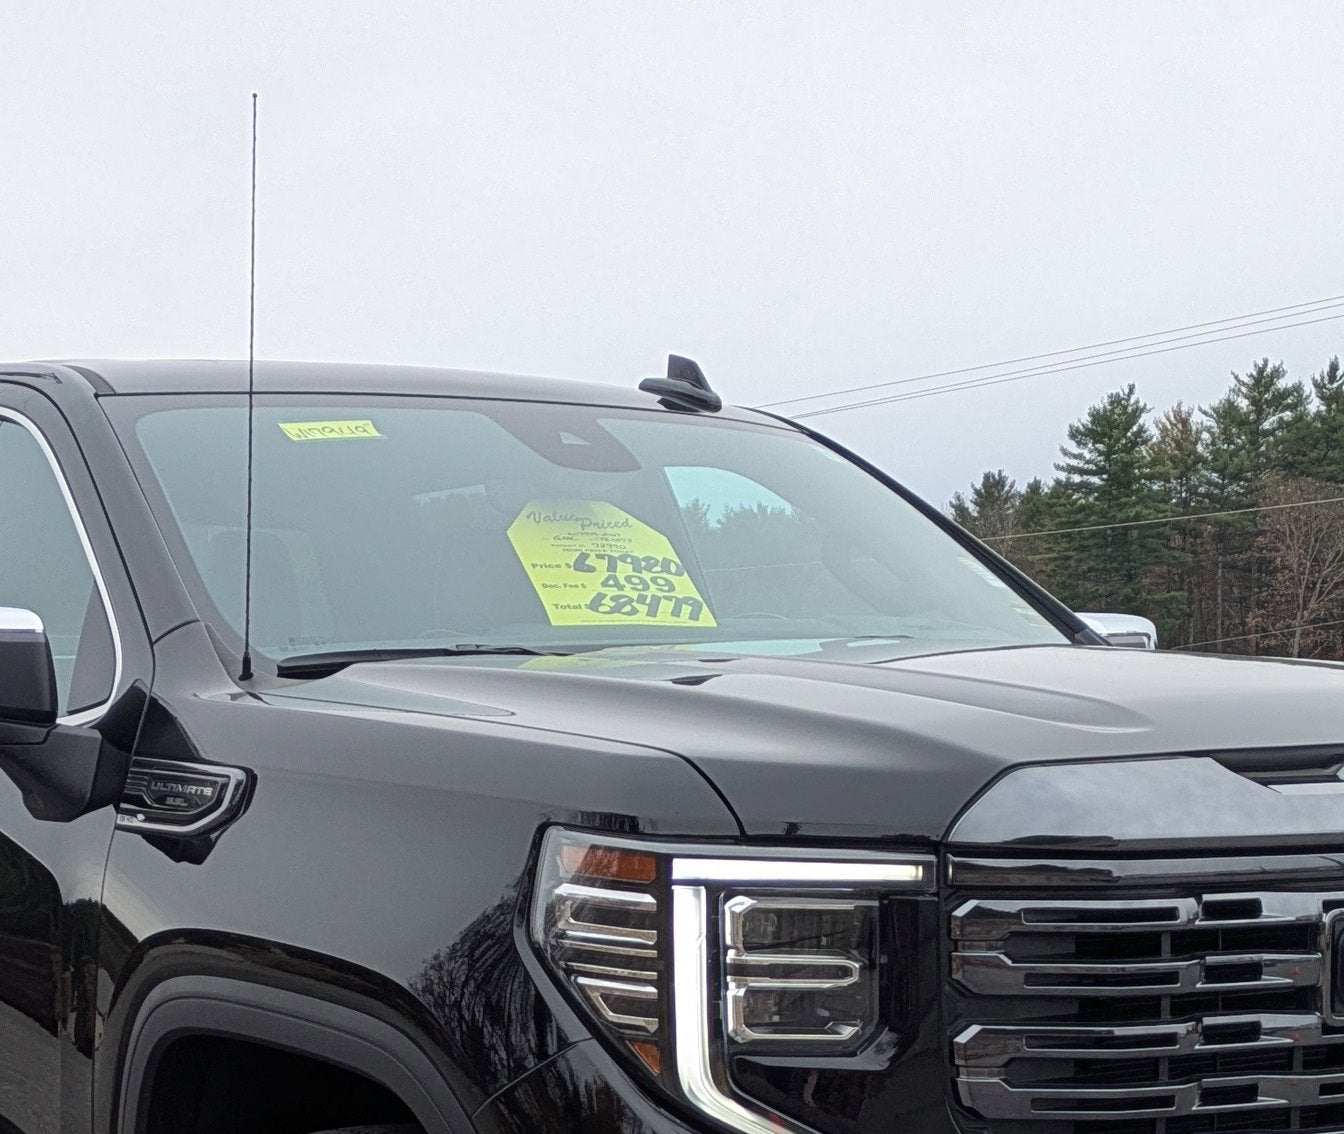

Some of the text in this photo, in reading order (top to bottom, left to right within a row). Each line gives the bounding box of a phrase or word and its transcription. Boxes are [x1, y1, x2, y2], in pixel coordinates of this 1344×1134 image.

[526, 510, 632, 531] Value Priced
[601, 575, 676, 593] 499
[151, 780, 214, 796] ULTIMATE
